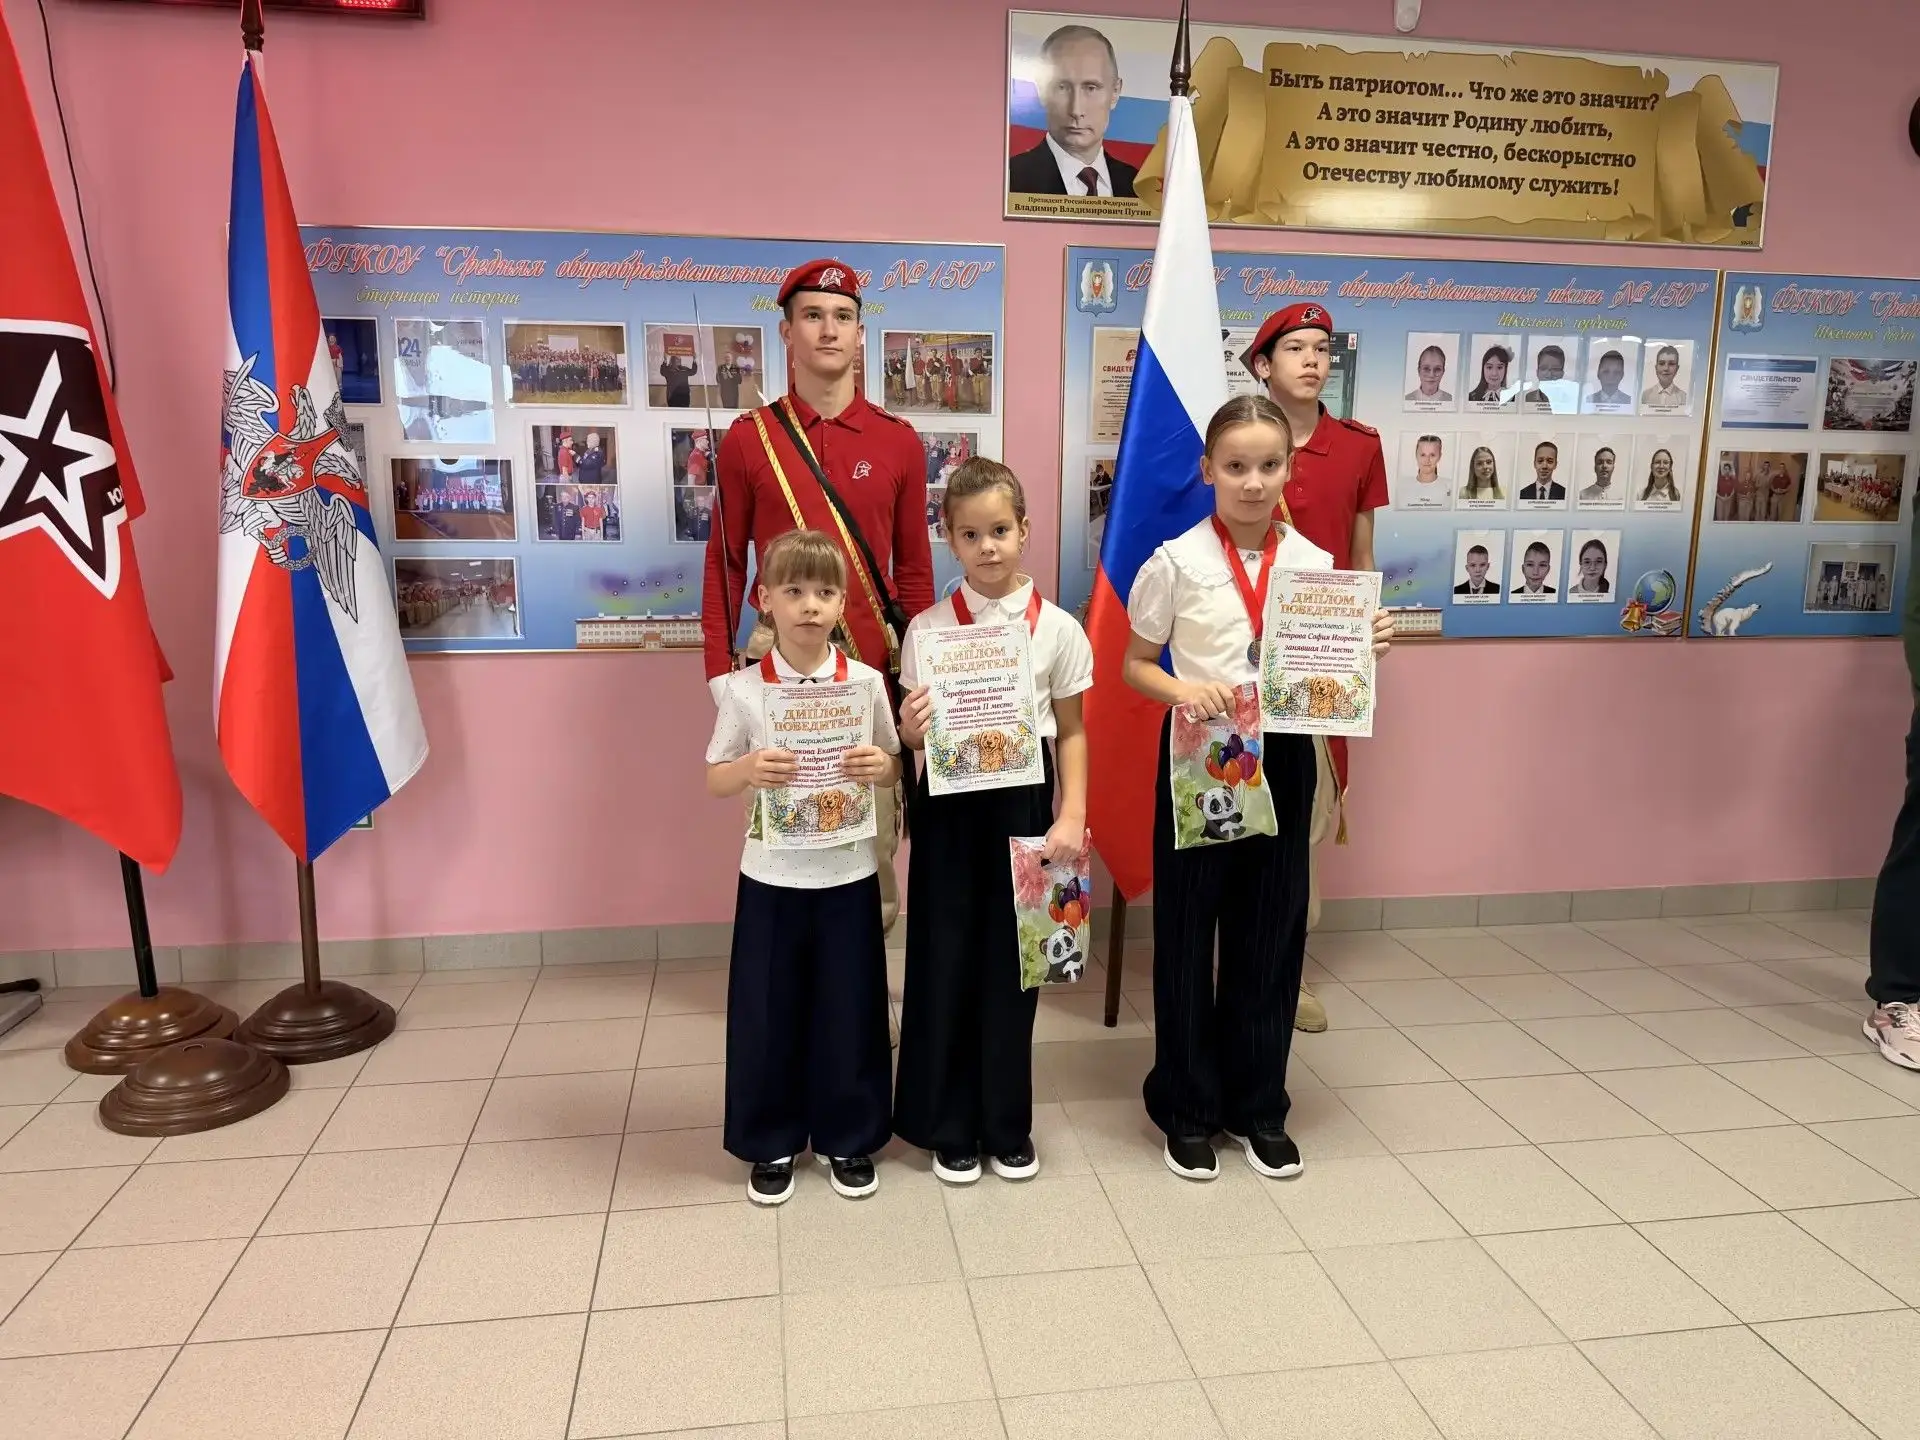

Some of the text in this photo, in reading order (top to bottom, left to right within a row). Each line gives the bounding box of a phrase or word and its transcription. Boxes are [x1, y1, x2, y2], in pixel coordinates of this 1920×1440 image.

[1269, 69, 1659, 112] Быть патриотом... Что же это значит?
[1317, 102, 1613, 142] А это значит Родину любить,
[1286, 131, 1636, 171] А это значит честно, бескорыстно
[1302, 161, 1619, 200] Отечеству любимому служить!
[1028, 196, 1063, 204] Президент
[1103, 199, 1139, 207] Федерации
[1014, 203, 1152, 217] Владимир Владимирович Путин
[304, 237, 426, 275] ФГКОУ
[1337, 270, 1540, 308] общеобразовательная
[1544, 277, 1604, 306] школа
[450, 289, 522, 311] истории
[1771, 283, 1863, 316] ФГКОУ
[1291, 592, 1356, 606] ДИПЛОМ
[1280, 603, 1365, 618] ПОБЕДИТЕЛЯ
[1299, 621, 1345, 630] награждается
[1275, 631, 1364, 643] Петрова София Игоревна
[942, 646, 1007, 663] ДИПЛОМ
[1284, 644, 1354, 654] занявшая III место
[932, 657, 1019, 675] ПОБЕДИТЕЛЯ
[954, 675, 1002, 686] награждается
[942, 685, 1016, 699] Серебрякова Евгения
[946, 701, 1013, 714] занявшая II место
[956, 694, 1003, 706] Дмитриевна
[783, 706, 852, 721] ДИПЛОМ
[774, 716, 863, 732] ПОБЕДИТЕЛЯ
[796, 735, 845, 746] награждается
